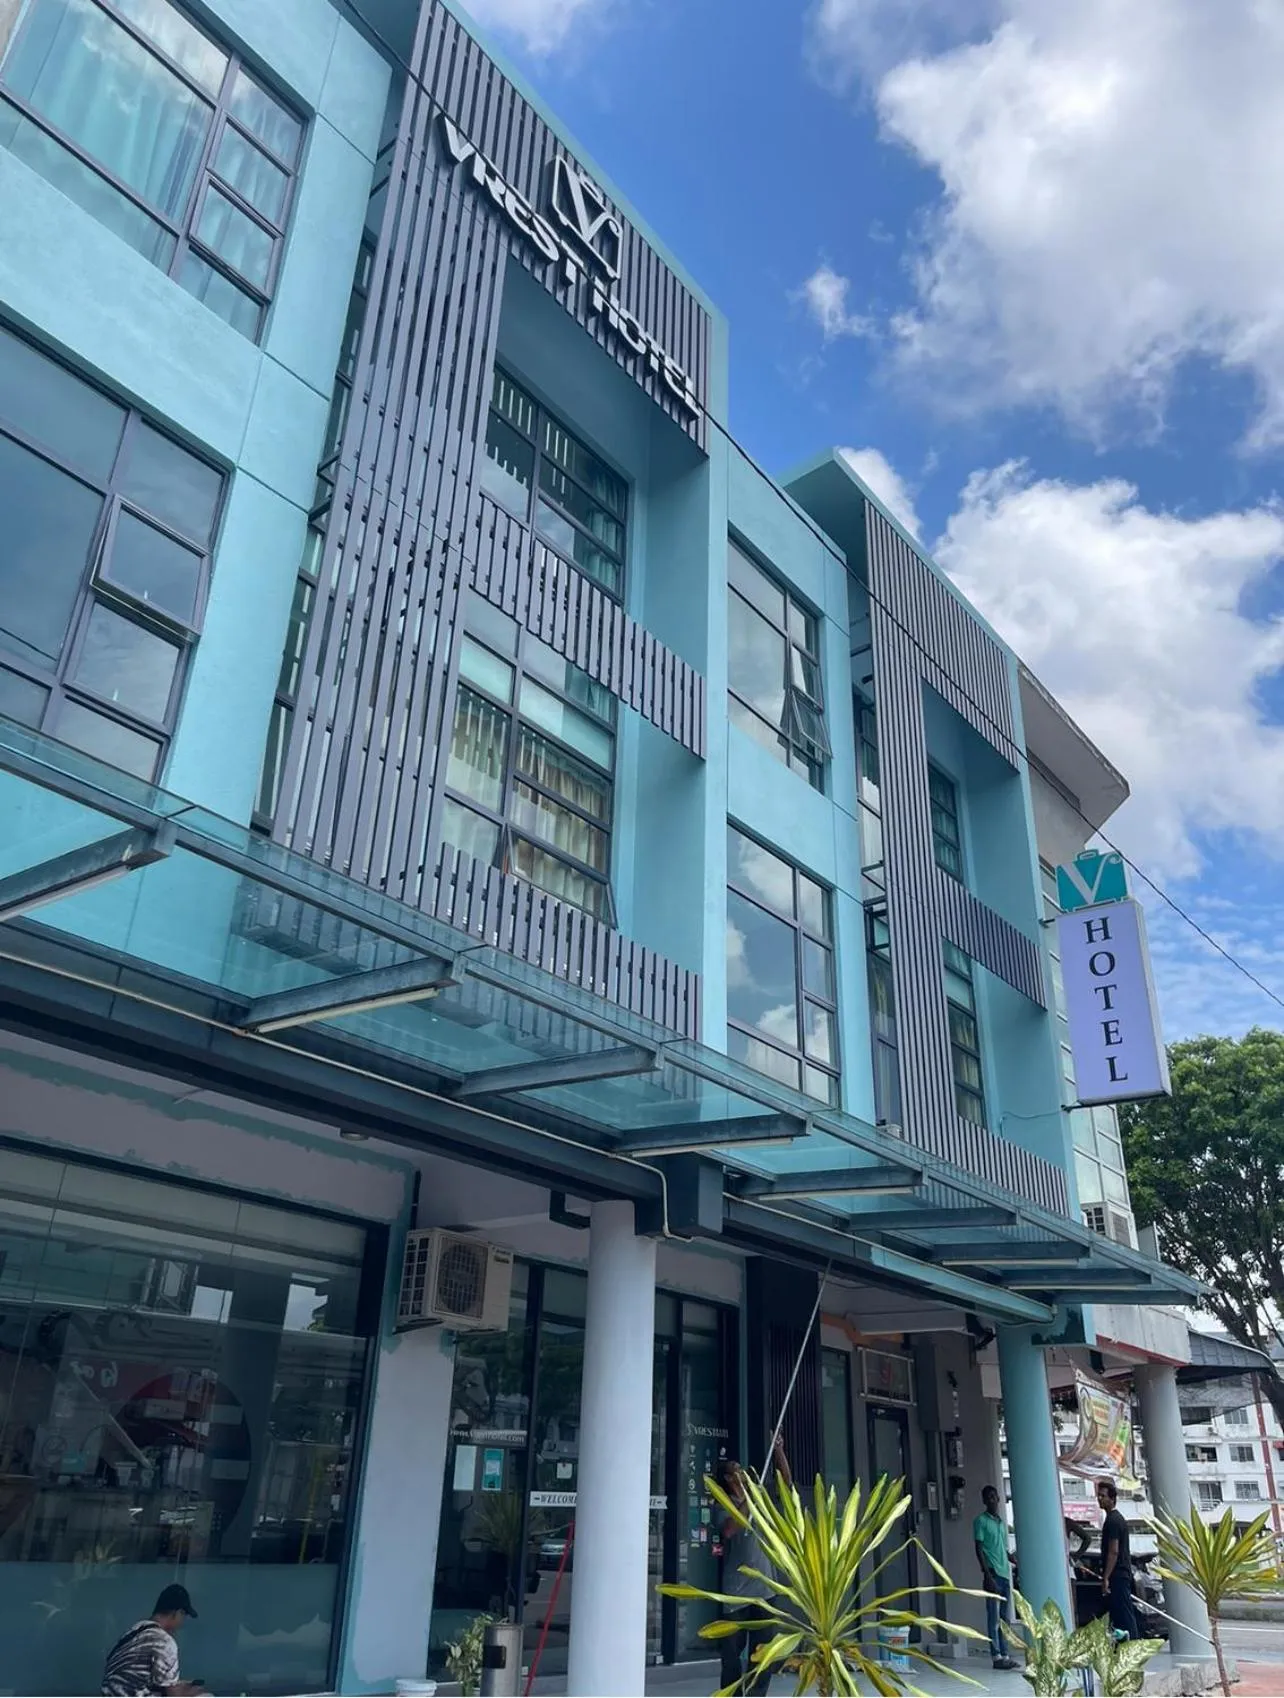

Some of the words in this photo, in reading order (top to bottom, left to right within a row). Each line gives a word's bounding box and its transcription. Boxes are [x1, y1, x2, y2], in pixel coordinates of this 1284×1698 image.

[437, 112, 583, 286] VREST
[590, 278, 702, 420] HOTEL
[1083, 916, 1128, 1082] HOTEL
